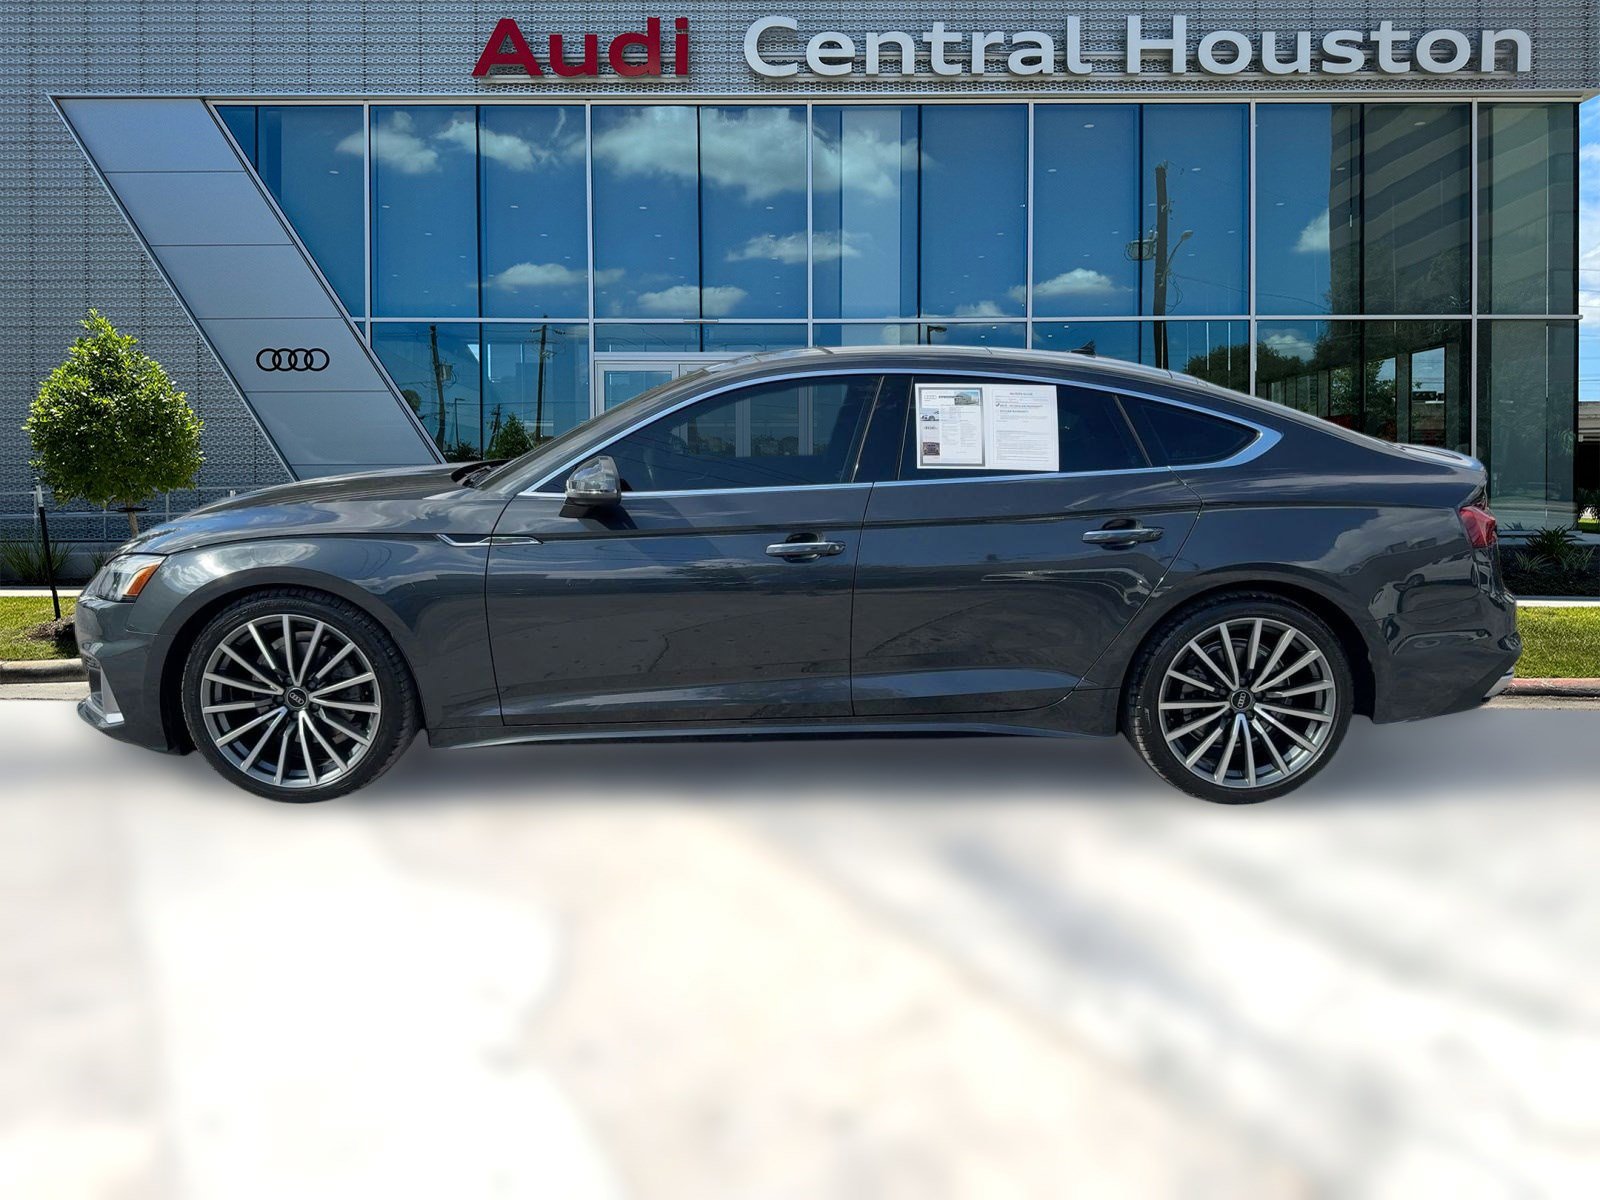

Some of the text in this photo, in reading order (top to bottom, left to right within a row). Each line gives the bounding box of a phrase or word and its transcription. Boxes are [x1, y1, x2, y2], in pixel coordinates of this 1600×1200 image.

[471, 15, 1532, 77] Audi Central Houston
